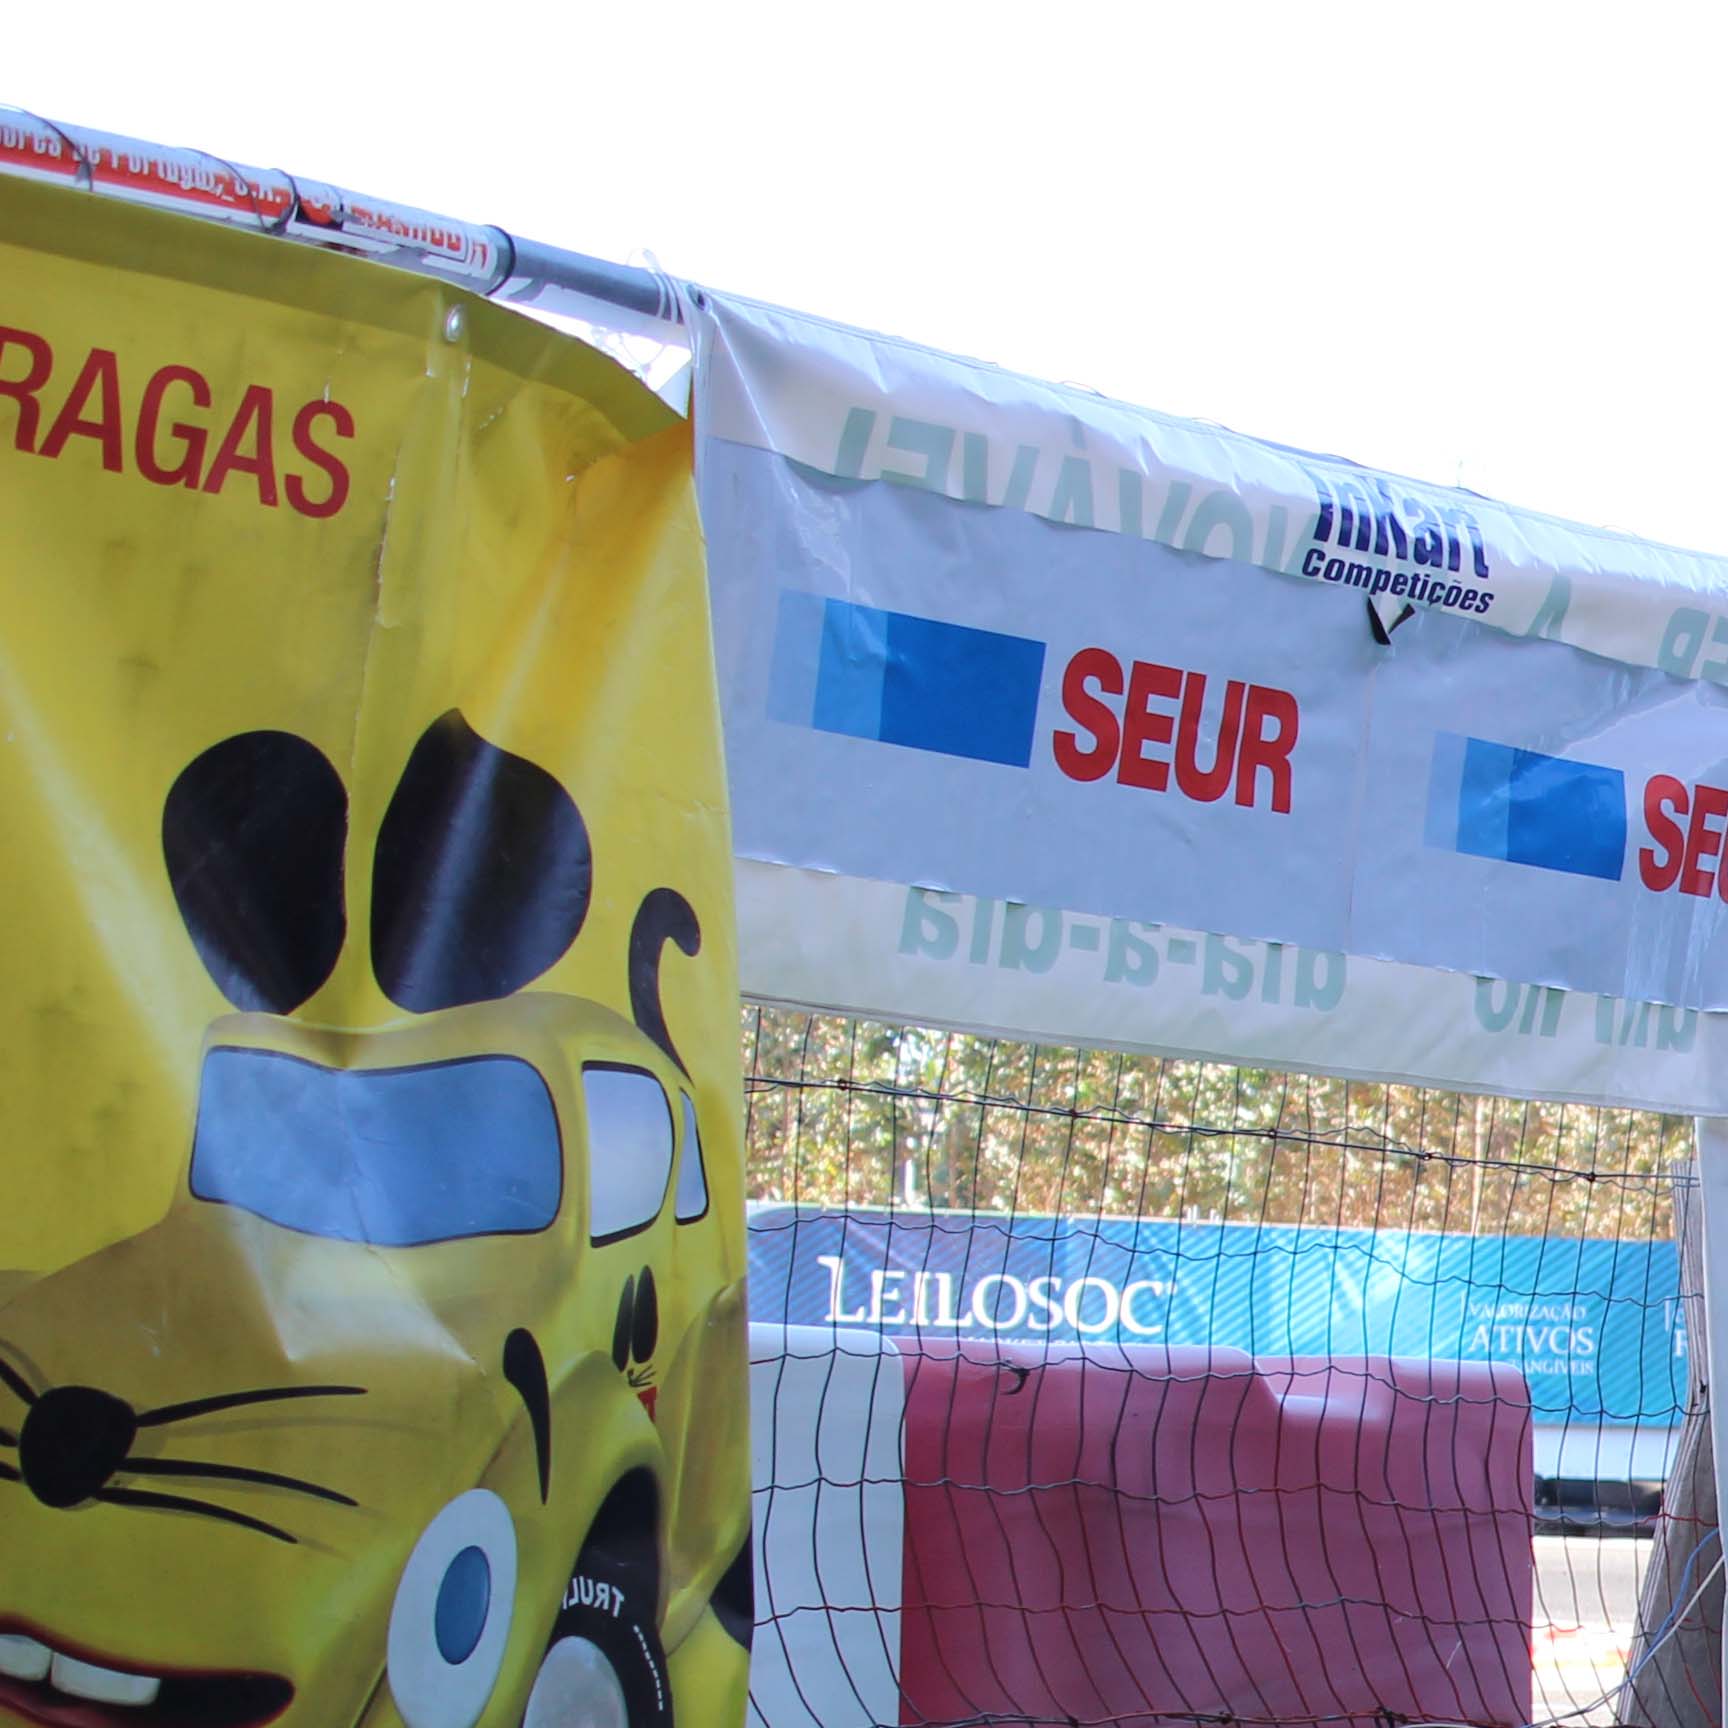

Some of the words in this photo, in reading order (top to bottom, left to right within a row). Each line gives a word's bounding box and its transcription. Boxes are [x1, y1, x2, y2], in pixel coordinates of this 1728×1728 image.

[0, 326, 356, 519] RAGAS
[1301, 547, 1494, 614] Competições
[1053, 646, 1301, 815] SEUR
[1468, 1325, 1596, 1355] ATIVOS
